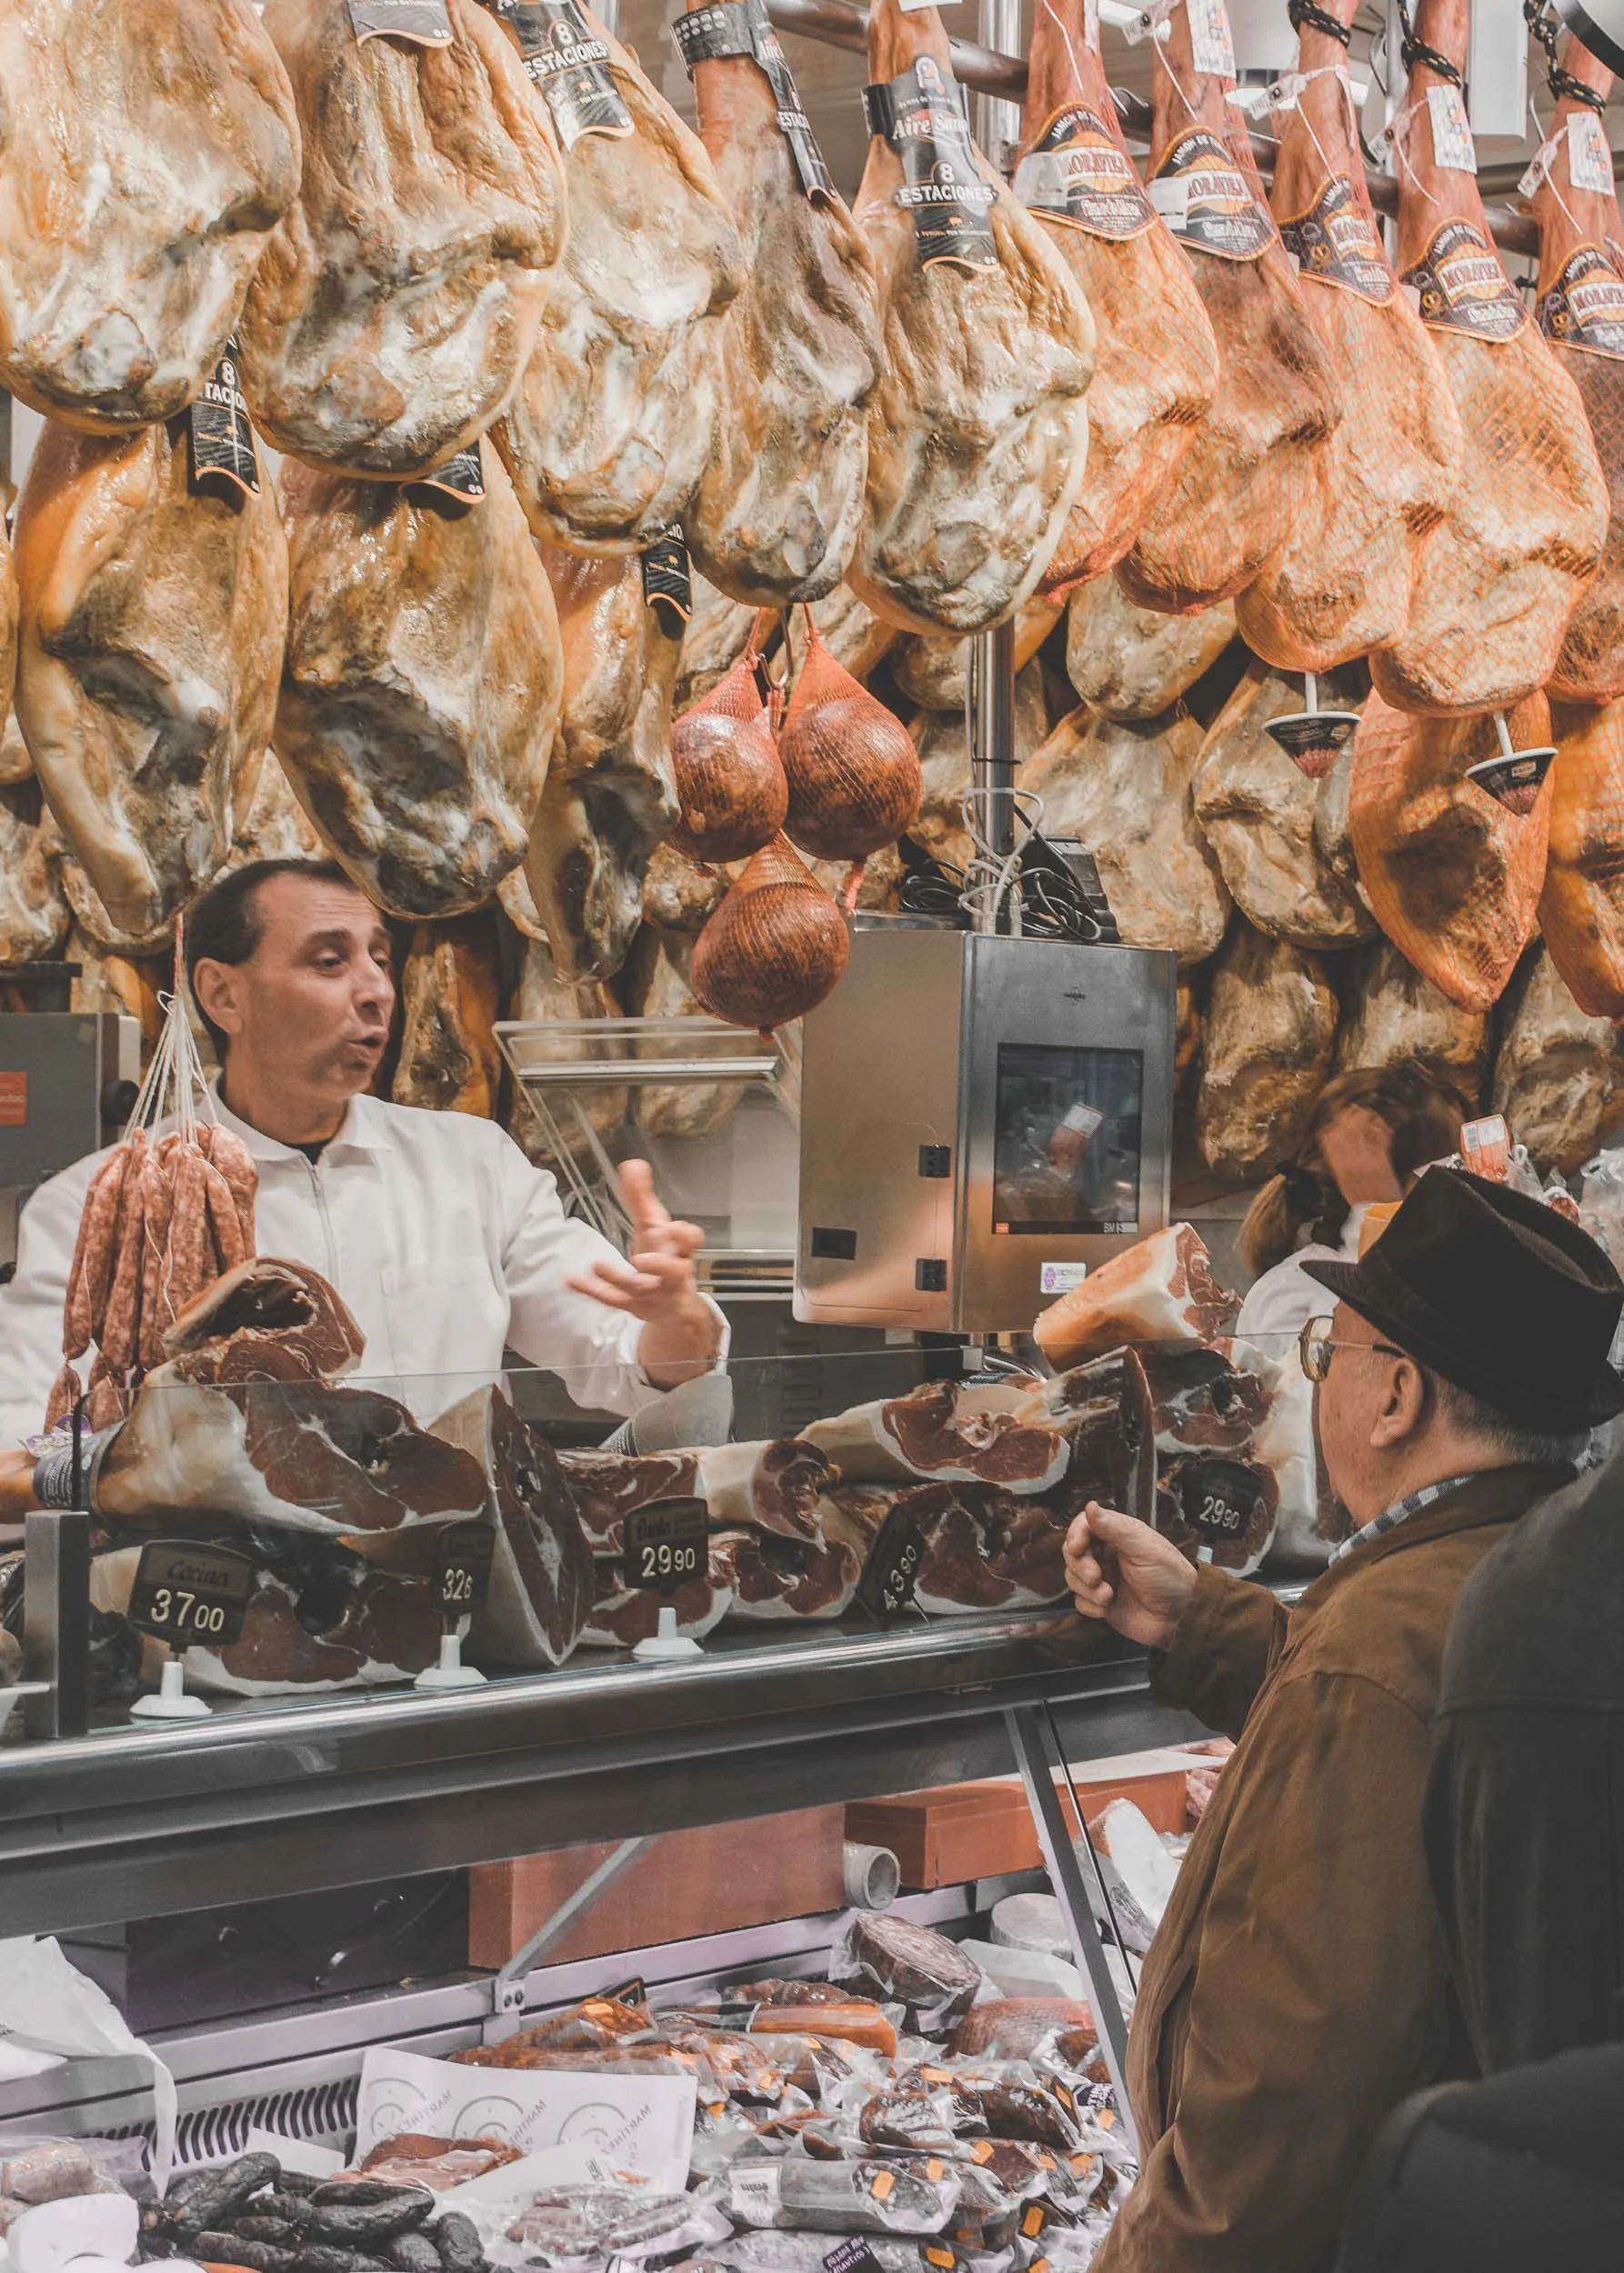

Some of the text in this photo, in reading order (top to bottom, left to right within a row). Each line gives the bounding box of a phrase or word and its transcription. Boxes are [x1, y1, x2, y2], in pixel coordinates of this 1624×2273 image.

[556, 22, 574, 45] 8
[892, 115, 932, 141] Aire
[939, 163, 956, 183] 8
[898, 185, 993, 205] ESTACIONES
[221, 361, 236, 386] 8
